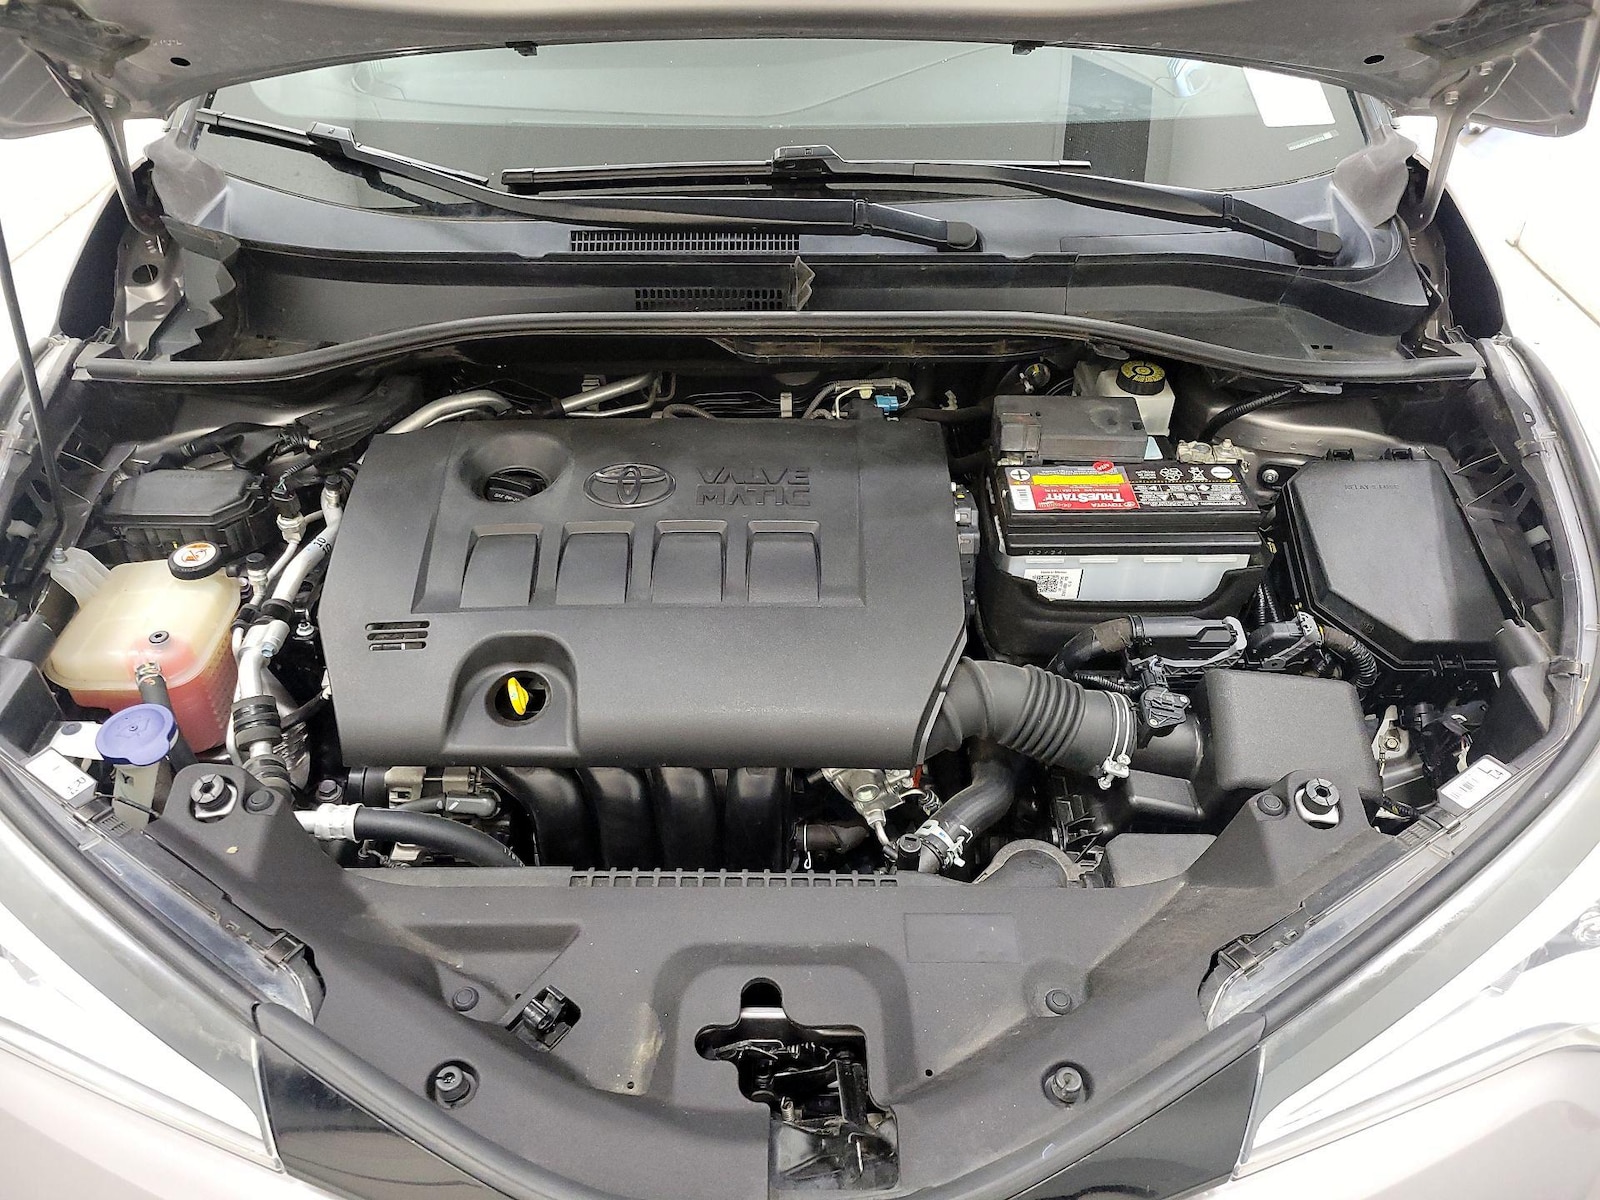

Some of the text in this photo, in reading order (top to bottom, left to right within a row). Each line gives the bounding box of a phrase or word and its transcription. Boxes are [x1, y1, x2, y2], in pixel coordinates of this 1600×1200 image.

[695, 467, 809, 485] VALVE
[695, 485, 811, 507] MATIC
[1045, 492, 1125, 502] TRUESTART
